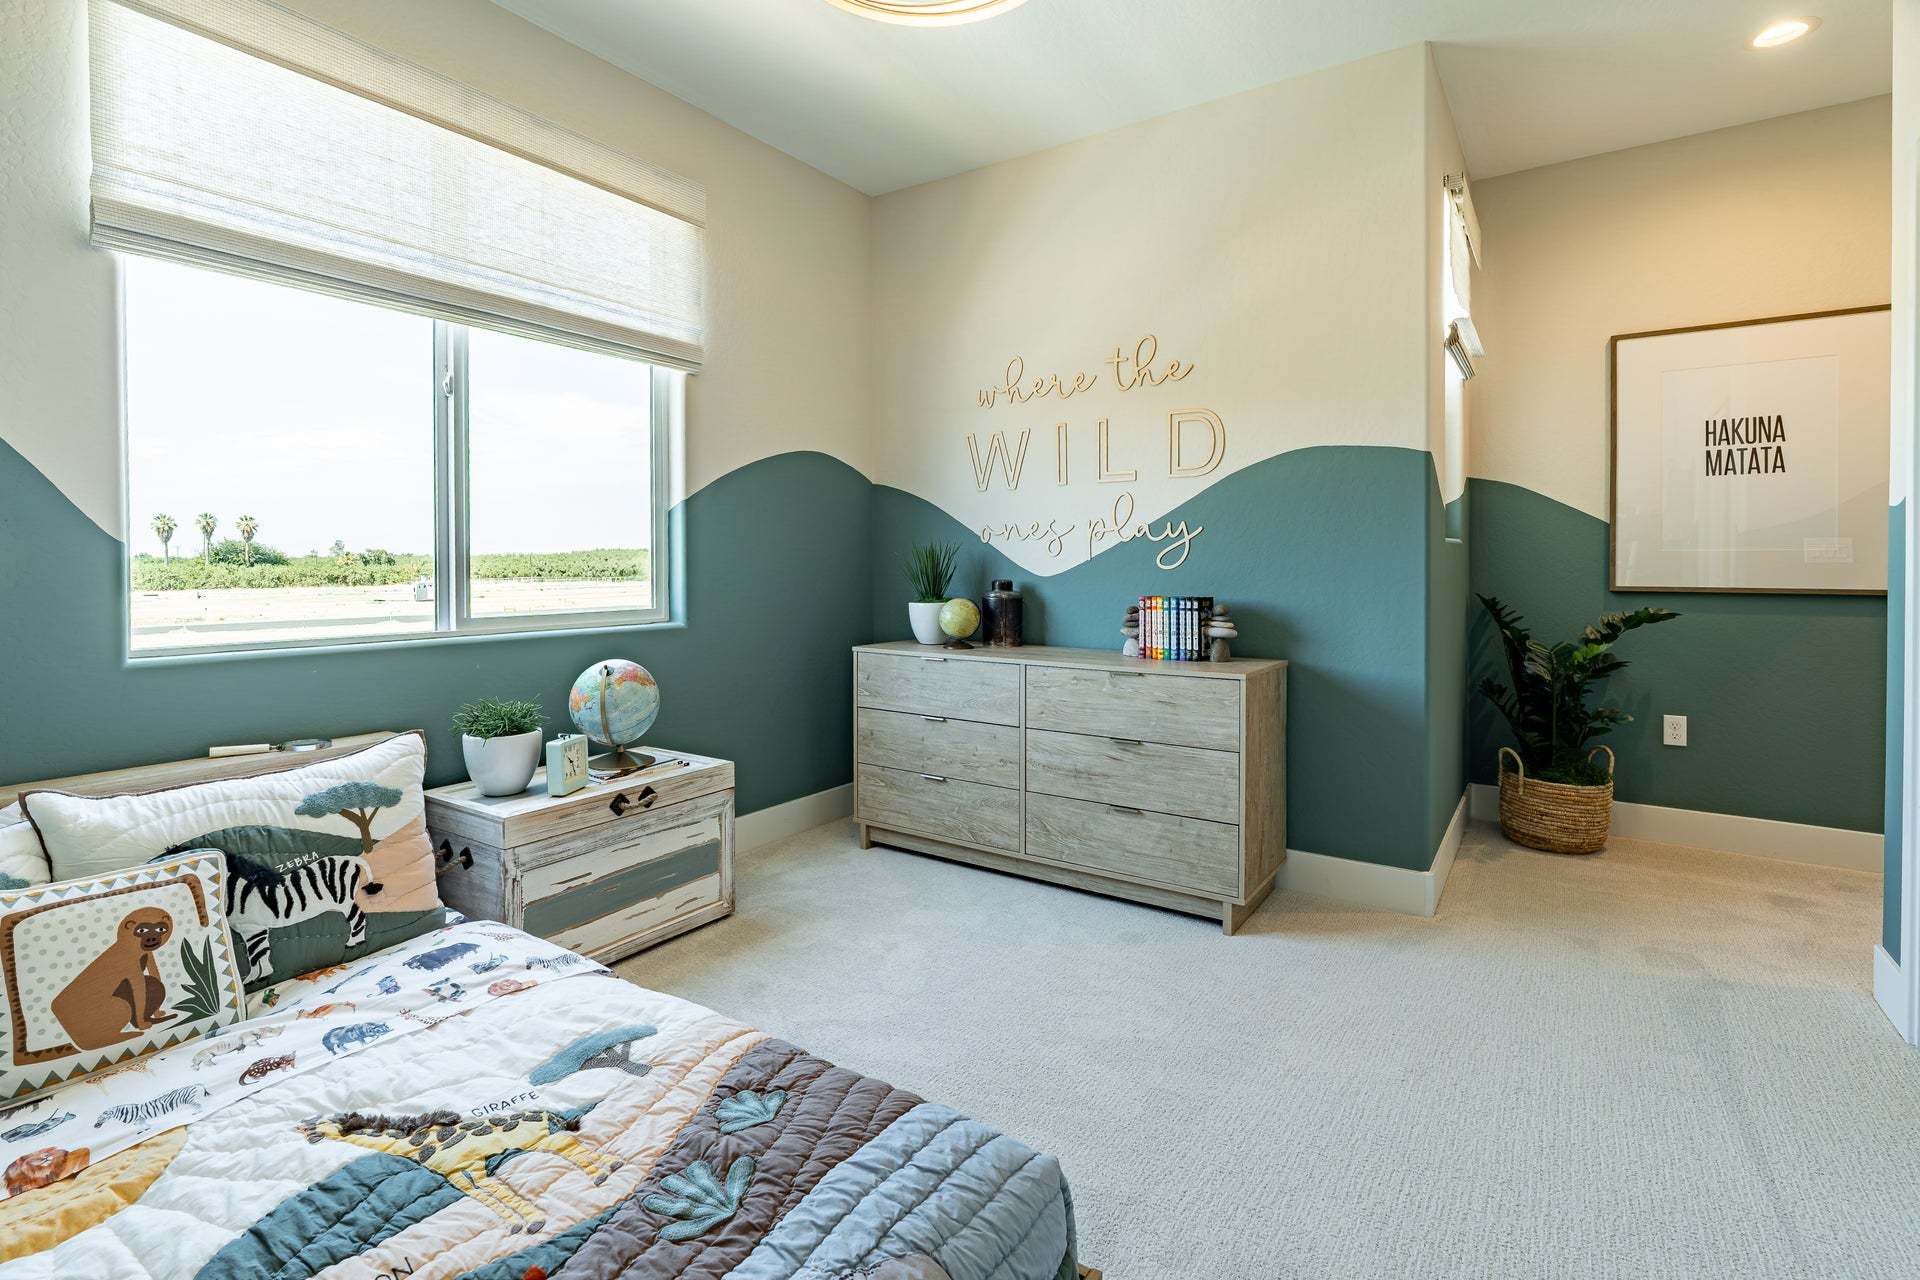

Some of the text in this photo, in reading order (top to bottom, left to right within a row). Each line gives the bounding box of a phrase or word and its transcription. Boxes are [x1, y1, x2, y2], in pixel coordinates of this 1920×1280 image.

[976, 334, 1194, 408] where the
[1705, 414, 1786, 447] HAKUNA
[966, 407, 1226, 491] WILD
[1705, 445, 1786, 476] MATATA
[980, 492, 1203, 570] ones play
[274, 851, 319, 873] ZEBRA
[471, 1090, 540, 1117] GIRAFFE
